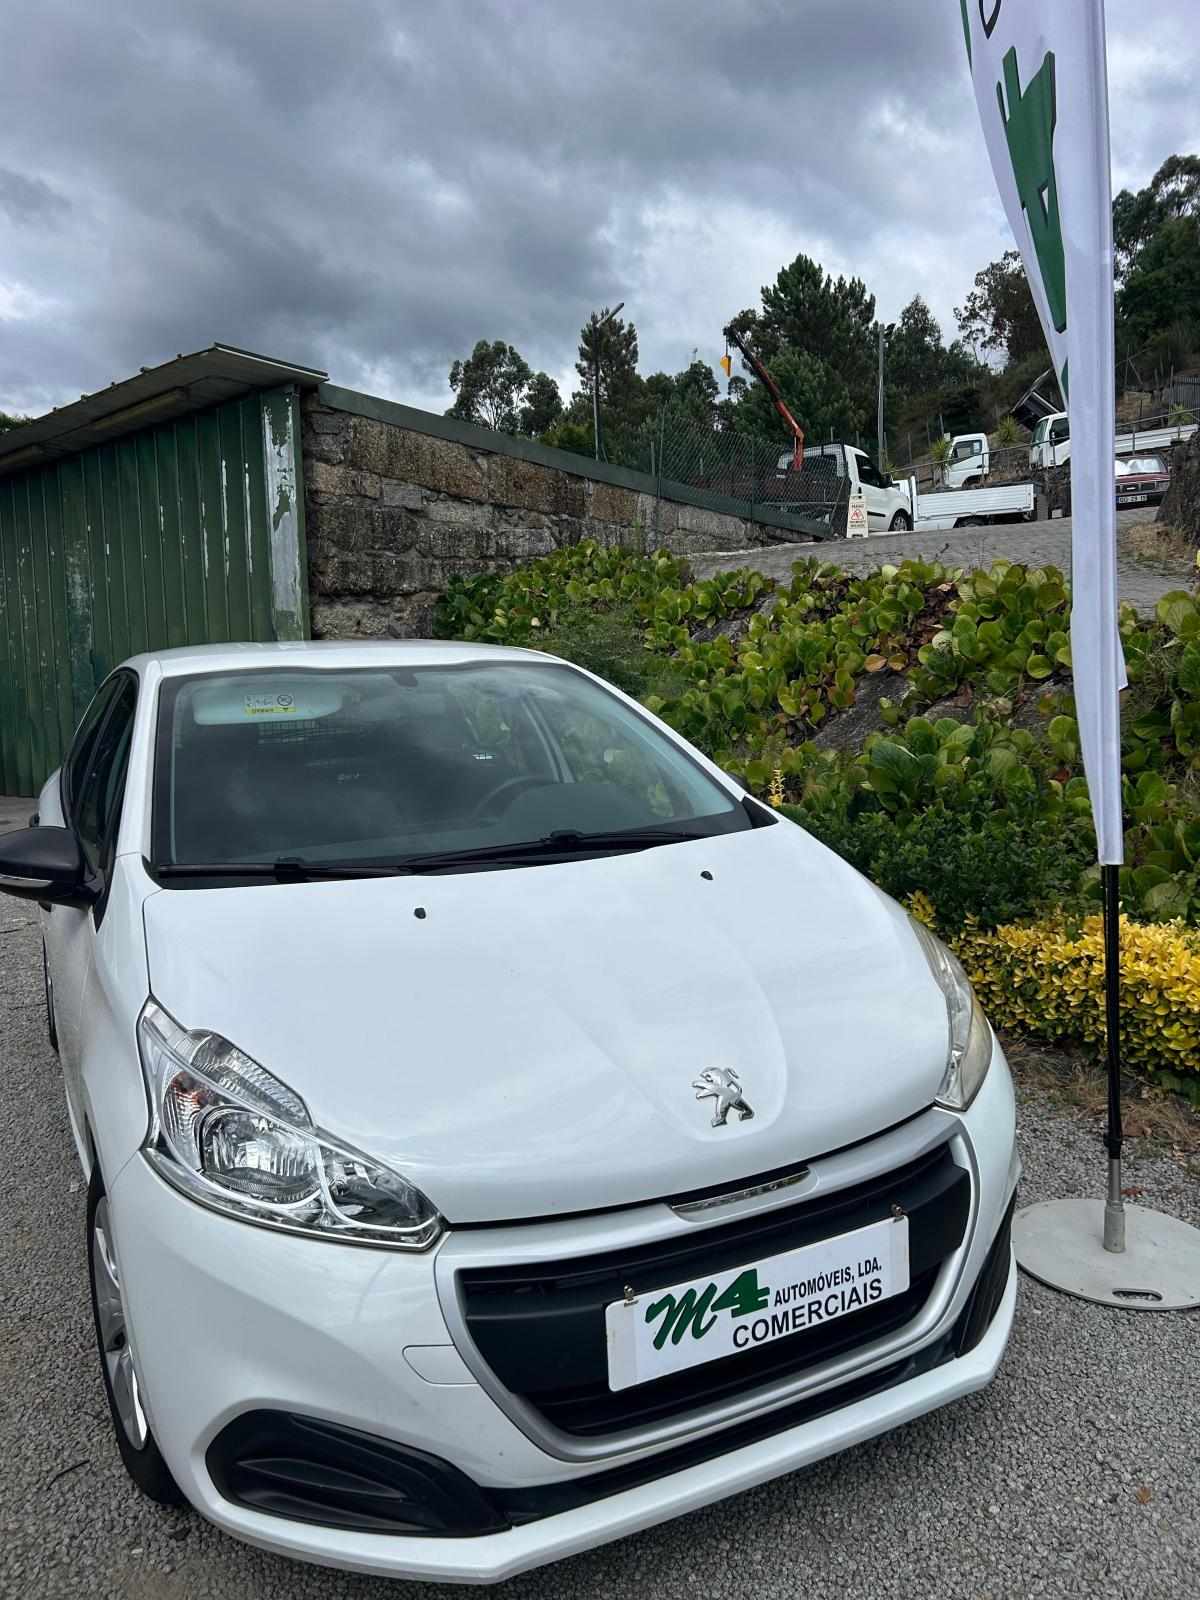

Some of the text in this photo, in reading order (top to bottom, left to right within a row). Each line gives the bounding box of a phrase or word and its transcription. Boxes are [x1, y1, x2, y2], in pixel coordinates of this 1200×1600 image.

[773, 1257, 882, 1307] AUTOMÓVEIS, LDA.
[732, 1278, 883, 1349] COMERCIAIS
